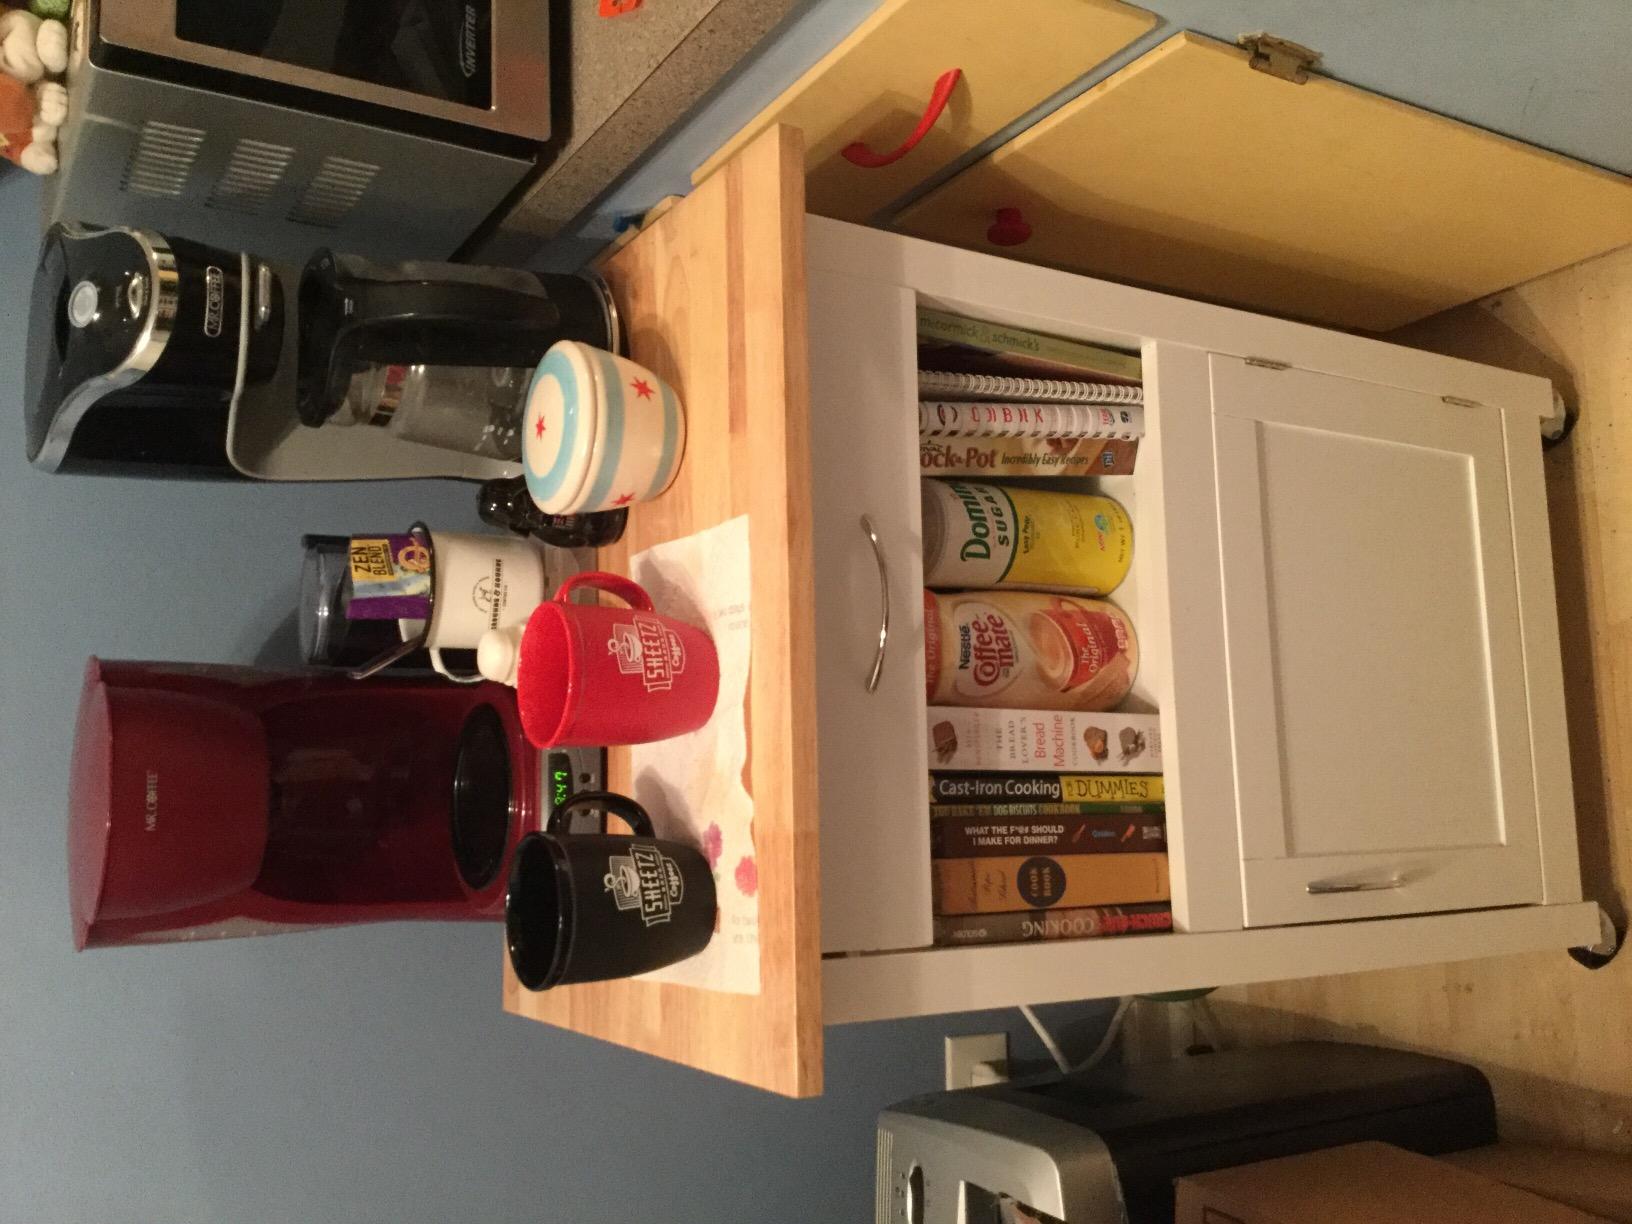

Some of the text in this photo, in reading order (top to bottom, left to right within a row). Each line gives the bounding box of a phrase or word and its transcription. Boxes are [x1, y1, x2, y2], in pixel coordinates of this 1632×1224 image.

[463, 4, 476, 74] INVERTER
[920, 444, 997, 468] ock-Pot
[1001, 452, 1040, 466] Incredibly
[1041, 453, 1060, 467] Easy
[951, 484, 991, 562] Domin
[351, 546, 371, 573] ZEN
[367, 545, 387, 576] BLEND
[638, 622, 665, 679] SHEETZ
[958, 624, 971, 670] Nestlé
[986, 613, 1014, 668] mate
[1077, 622, 1100, 673] Original
[1080, 647, 1090, 664] The
[995, 727, 1004, 750] THE
[1007, 720, 1016, 759] BREAD
[1032, 722, 1046, 759] Bread
[1053, 714, 1064, 767] Machine
[939, 779, 1003, 796] Cast-Iron
[1005, 779, 1060, 799] Cooking
[1075, 778, 1149, 800] DUMMIES
[993, 804, 1008, 816] DOG
[1008, 804, 1038, 816] BISCUITS
[964, 826, 989, 835] WHAT
[990, 825, 1008, 835] THE
[1031, 824, 1064, 834] SHOULD
[977, 836, 1003, 846] MAKE
[1004, 836, 1021, 845] FOR
[1023, 835, 1058, 845] DINNER?
[635, 852, 663, 912] SHEETZ
[1030, 867, 1038, 897] COOK
[1043, 866, 1052, 897] BOOK
[1021, 918, 1095, 938] COOKING
